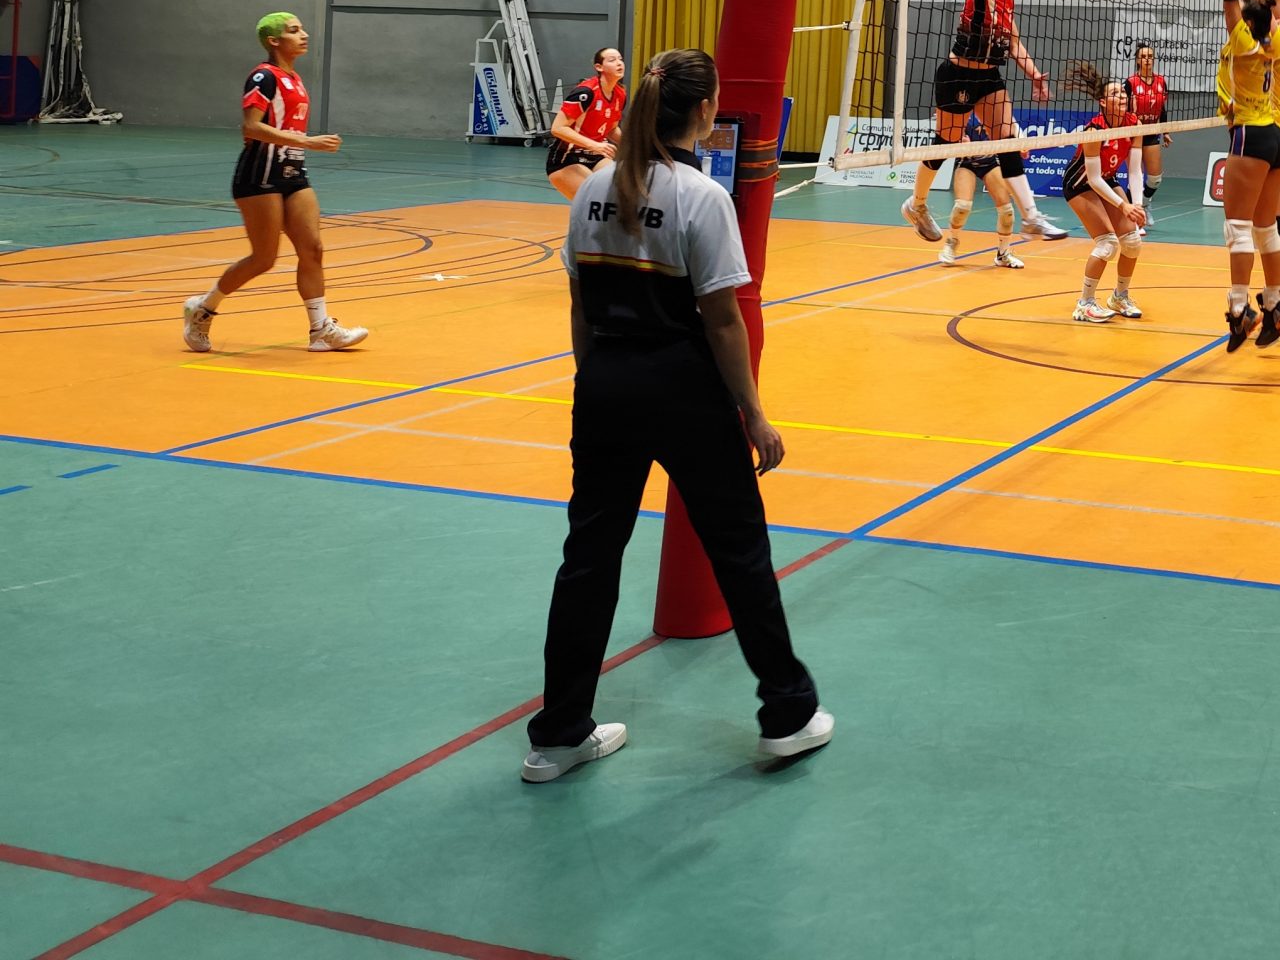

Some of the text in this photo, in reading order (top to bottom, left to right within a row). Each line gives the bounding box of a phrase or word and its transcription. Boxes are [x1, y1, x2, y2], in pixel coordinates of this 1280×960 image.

[597, 122, 607, 136] 4
[1029, 154, 1068, 164] Software
[1109, 154, 1118, 168] 9
[1036, 167, 1055, 175] todo
